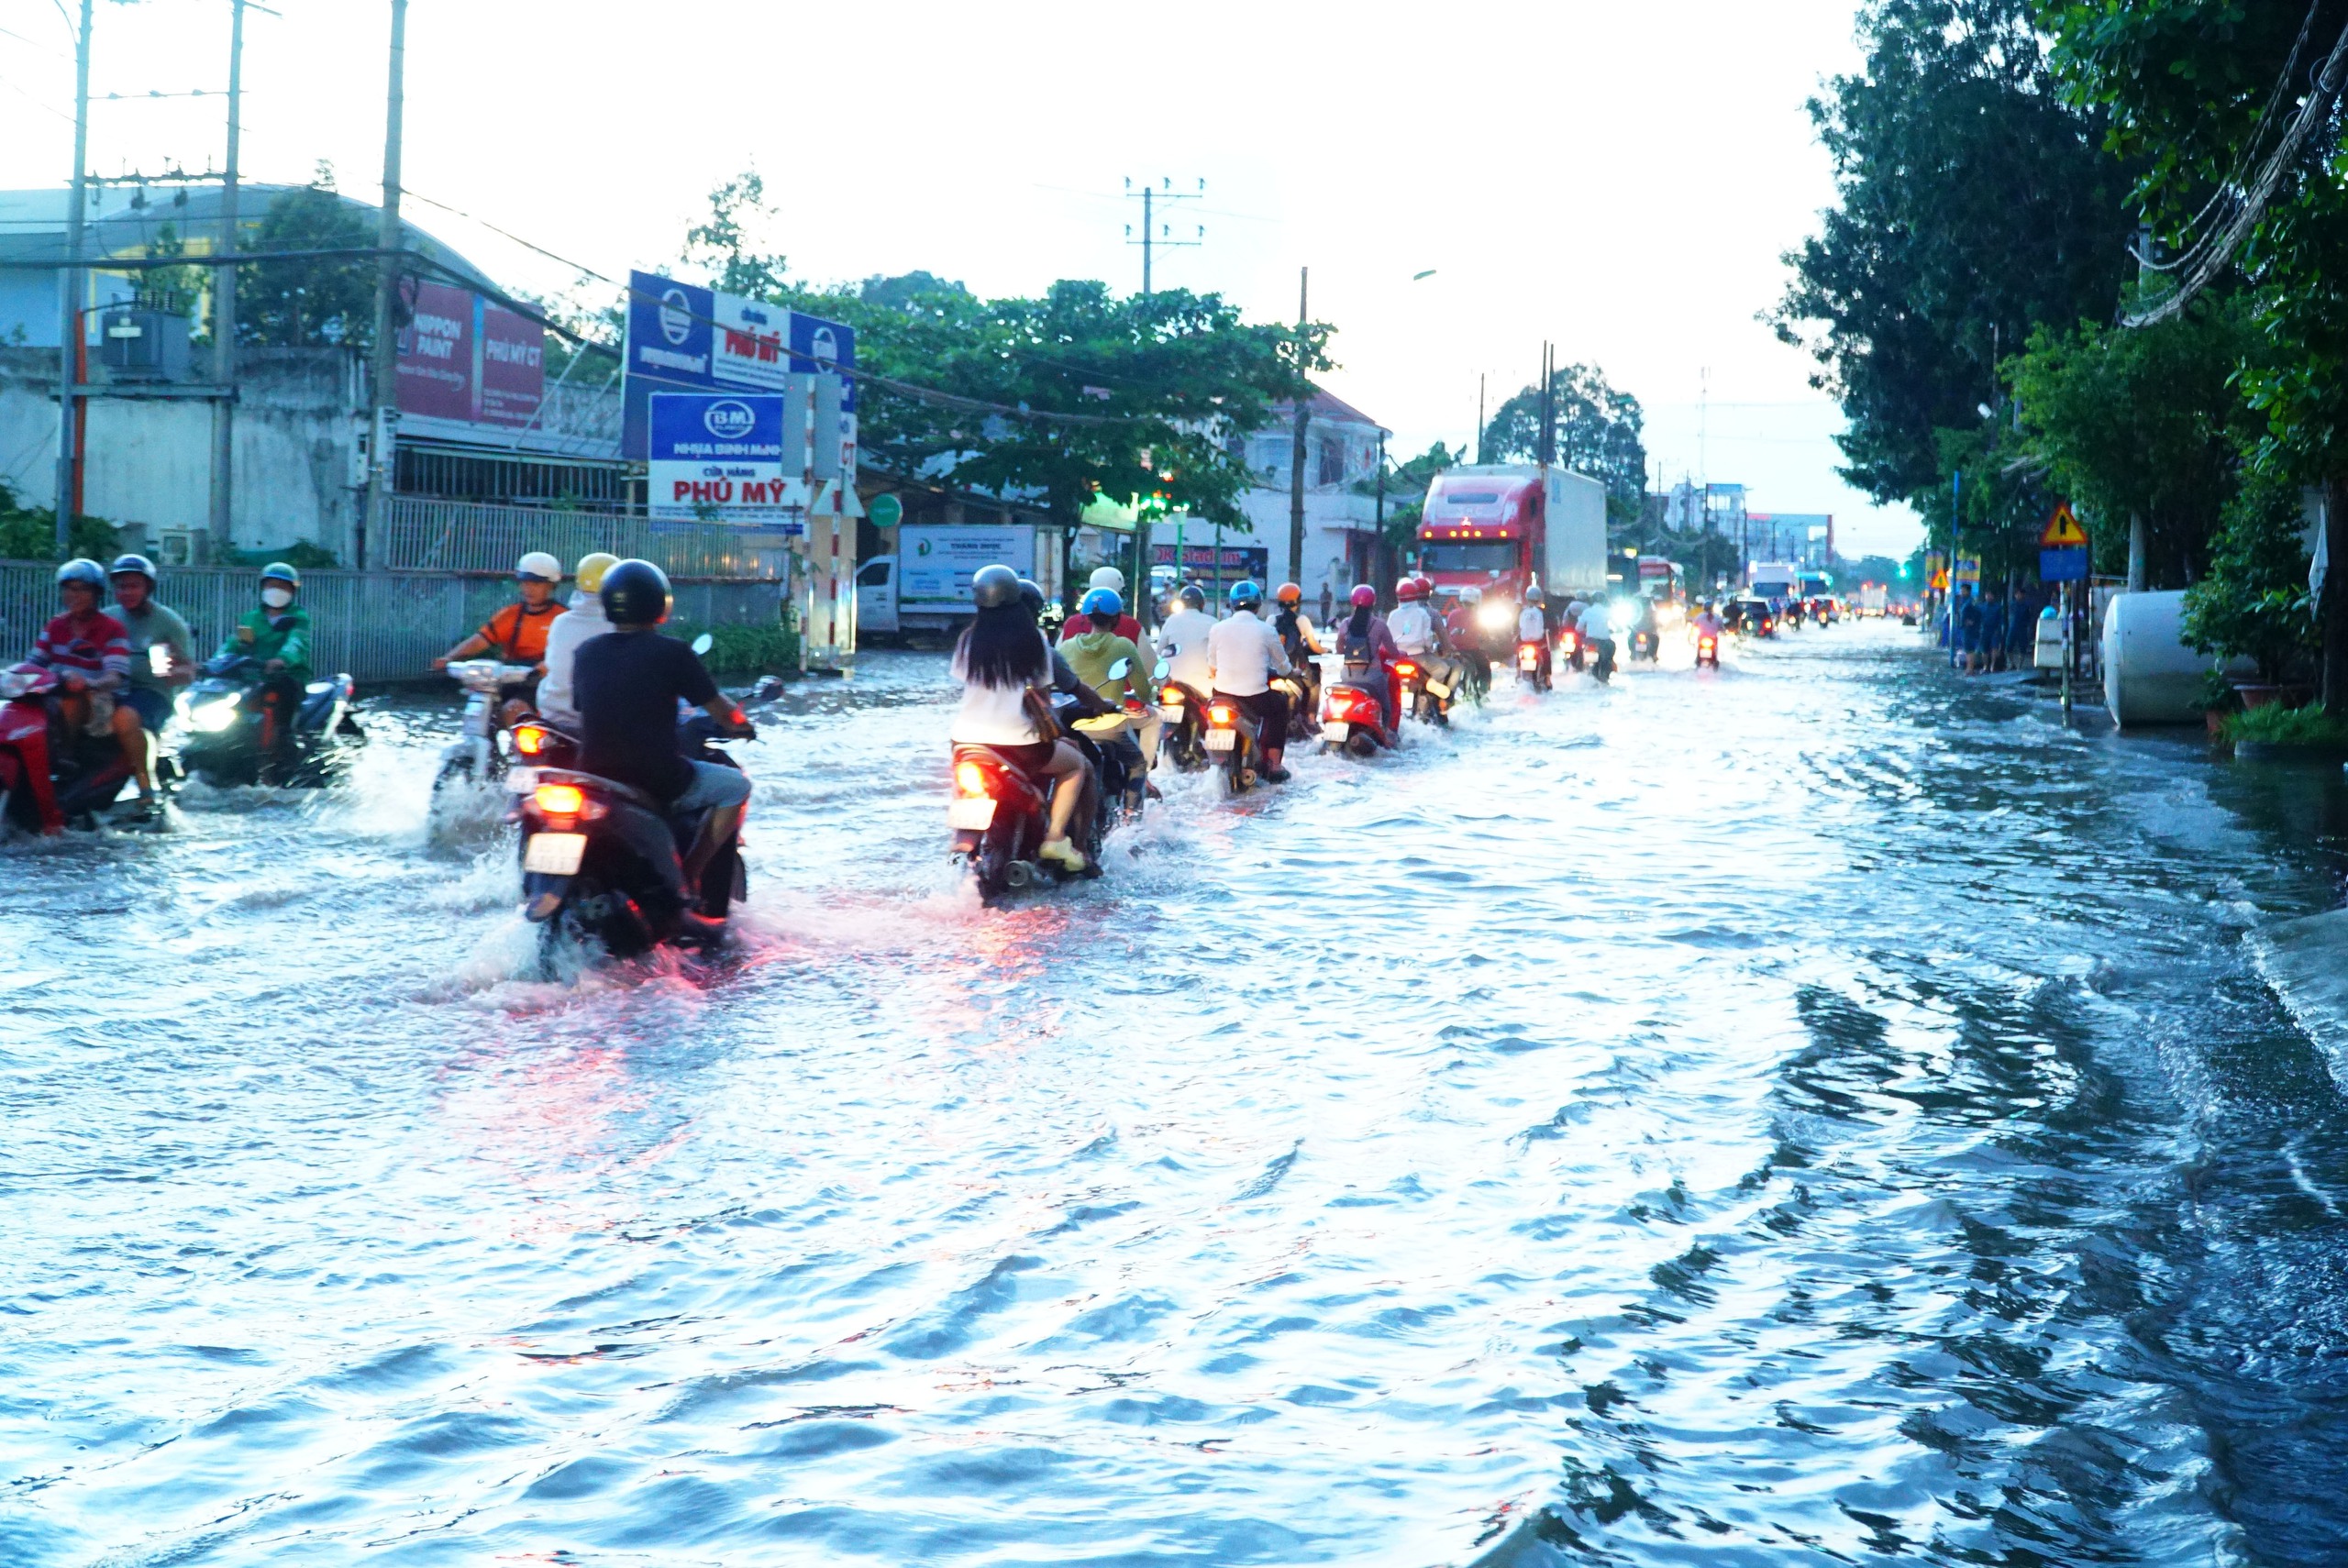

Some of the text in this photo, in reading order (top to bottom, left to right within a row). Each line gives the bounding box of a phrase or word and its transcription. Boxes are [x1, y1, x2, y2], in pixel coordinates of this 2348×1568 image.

[414, 313, 462, 340] NIPPON
[416, 334, 454, 359] PAINT
[673, 476, 787, 503] PHÚ MỸ
[1180, 547, 1241, 565] Stadum
